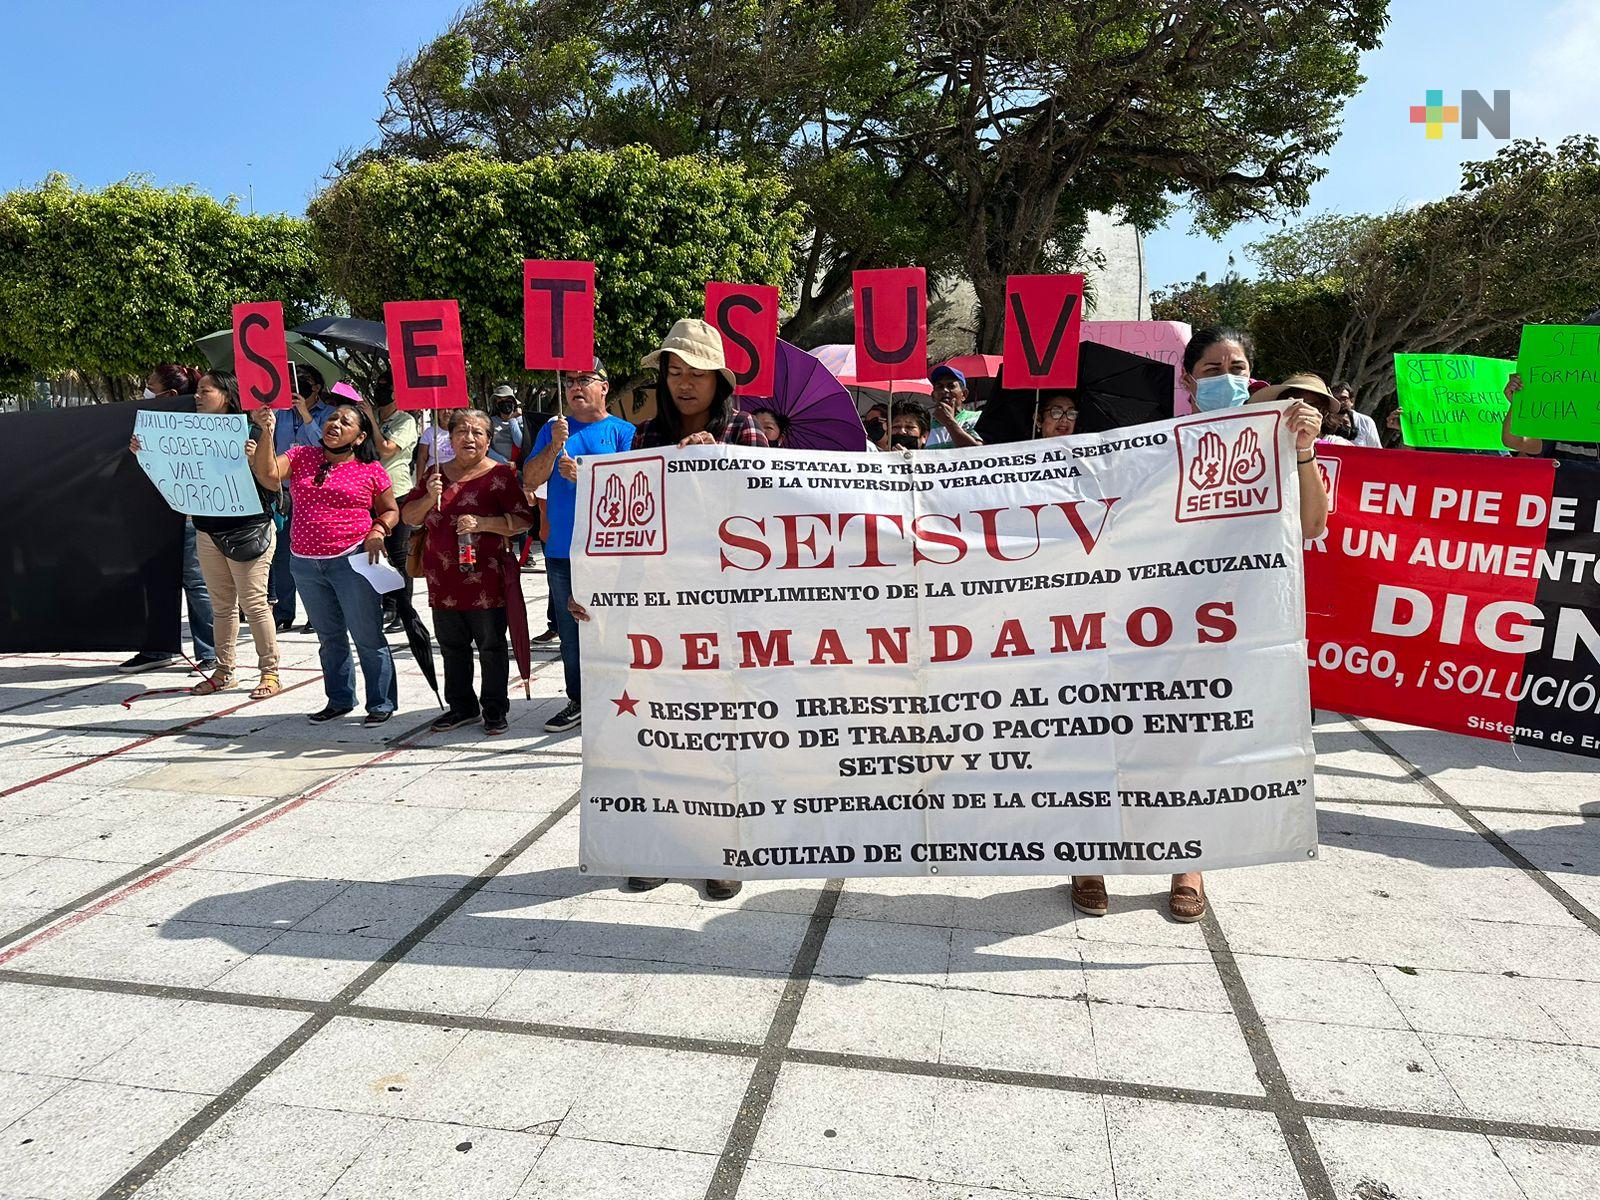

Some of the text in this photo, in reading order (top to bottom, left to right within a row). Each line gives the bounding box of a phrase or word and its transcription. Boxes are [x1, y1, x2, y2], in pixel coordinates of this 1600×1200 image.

[530, 278, 586, 359] T
[861, 286, 919, 365] U
[1009, 293, 1078, 377] V
[239, 312, 281, 404] S
[400, 319, 447, 389] E
[716, 295, 763, 386] S
[1407, 358, 1475, 384] SETSUV
[1409, 410, 1425, 425] LA
[1432, 409, 1471, 425] LUCHA
[1518, 400, 1578, 420] LUCHA
[159, 436, 240, 461] GOBIERNO
[667, 433, 1169, 475] SINDICATO ESTATAL DE TRABAJADORES AL SERVICIO
[169, 461, 206, 480] VALE
[747, 466, 1082, 492] DE LA UNIVERSIDAD VERACRUZANA
[1187, 487, 1269, 513] SETSUV
[1359, 481, 1417, 517] EN
[1430, 487, 1502, 524] PIE
[1516, 493, 1578, 531] DE
[594, 530, 657, 548] SETSUV
[718, 497, 1121, 573] SETSUV
[1342, 527, 1397, 562] UN
[590, 552, 1287, 607] ANTE EL INCUMPLIMIENTO DE LA UNIVERSIDAD VERACUZANA
[627, 601, 1238, 671] DEMANDAMOS
[648, 678, 1233, 721] RESPETO IRRESTRICTO AL CONTRATO
[637, 709, 1254, 751] COLECTIVO DE TRABAJO PACTADO ENTRE
[1467, 715, 1544, 741] Sistema
[1550, 729, 1576, 745] de
[838, 751, 1033, 777] SETSUV Y UV.
[590, 779, 1308, 818] “POR LA UNIDAD Y SUPERACIÓN DE LA CLASE TRABAJADORA”
[723, 840, 1203, 867] FACULTAD DE CIENCIAS QUIMICAS
